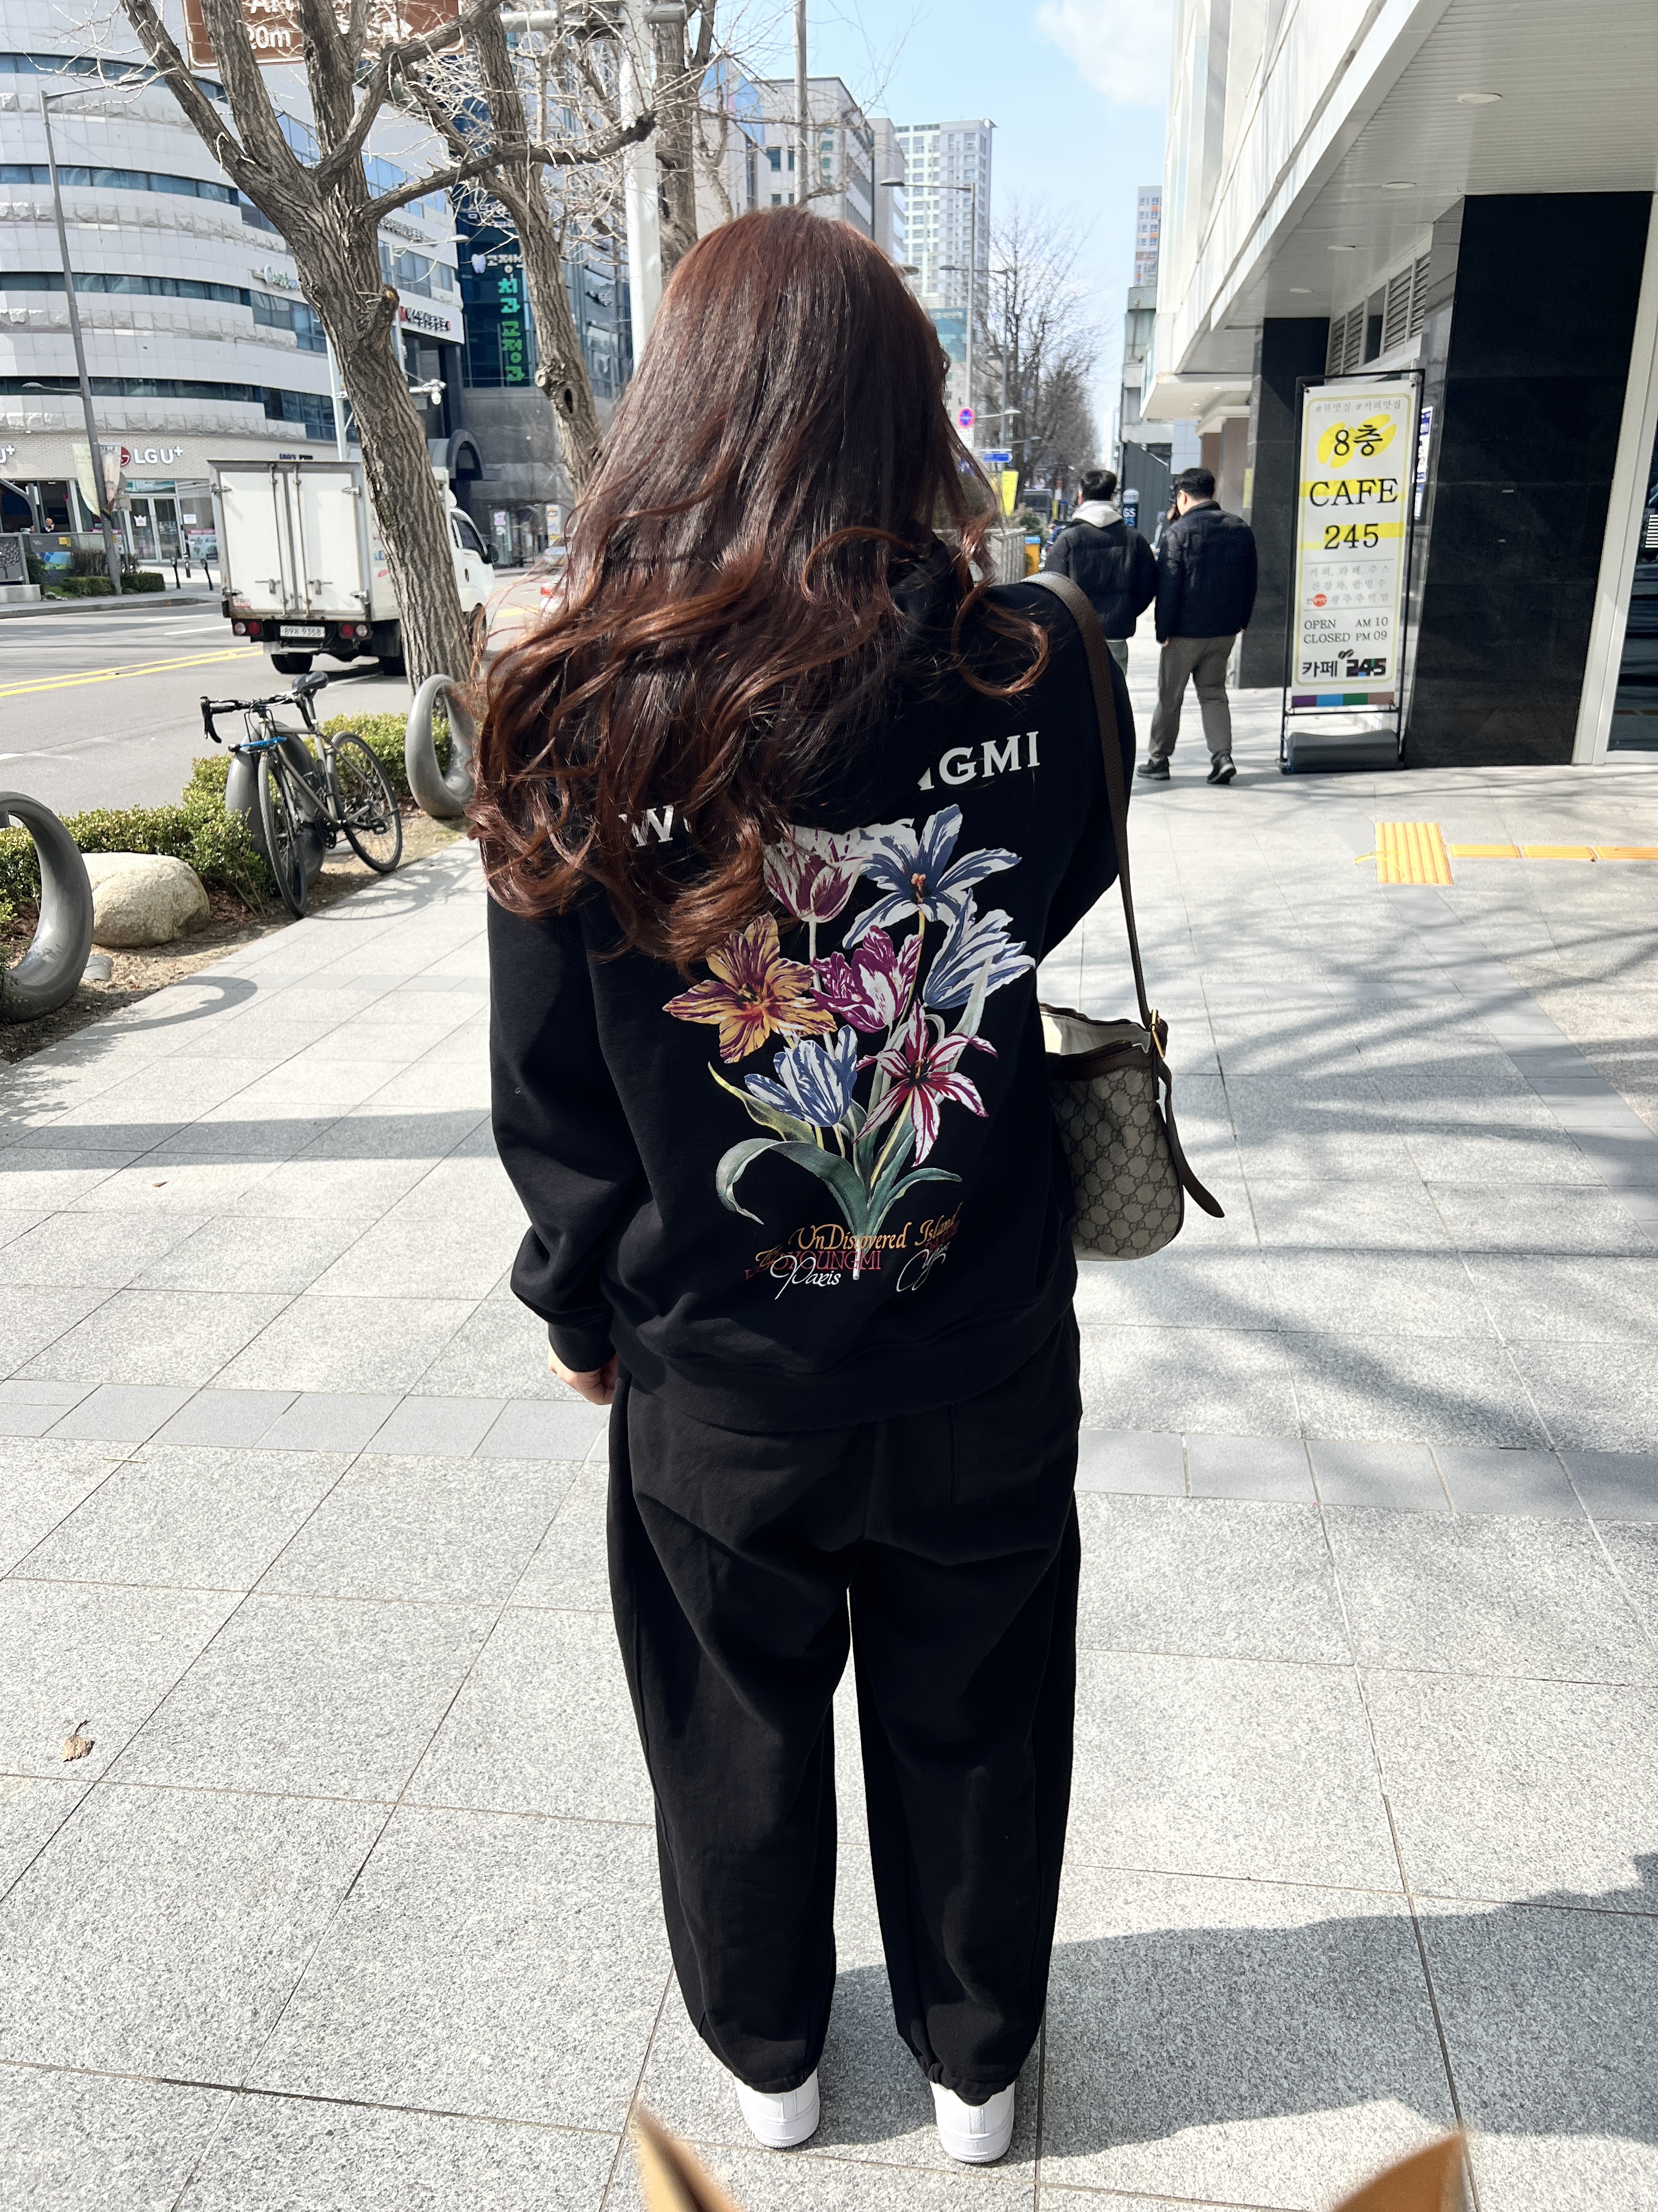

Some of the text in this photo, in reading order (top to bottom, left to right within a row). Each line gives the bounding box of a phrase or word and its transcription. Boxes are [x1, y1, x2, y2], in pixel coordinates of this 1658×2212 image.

[1334, 425, 1383, 456] 8층
[1309, 478, 1398, 507] CAFE
[1324, 523, 1379, 550] 245
[1304, 617, 1389, 630] OPEN AM 10
[1304, 630, 1388, 644] CLOSED PM 09
[1301, 658, 1386, 678] 카페 245
